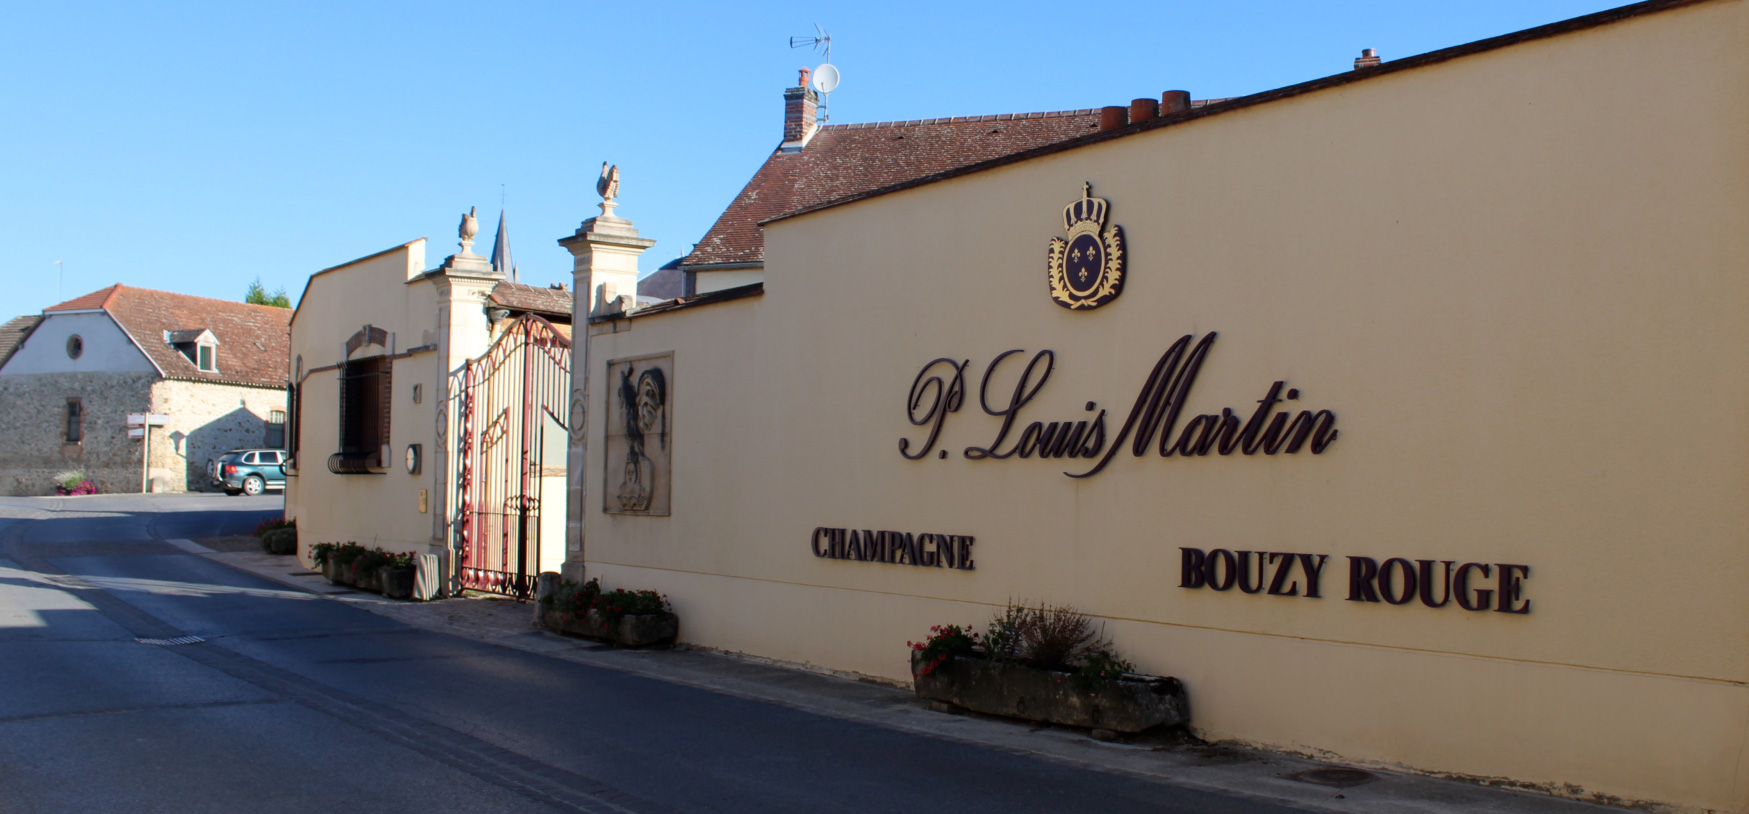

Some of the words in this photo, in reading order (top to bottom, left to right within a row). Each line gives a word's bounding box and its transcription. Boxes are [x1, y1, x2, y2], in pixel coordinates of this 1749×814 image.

[963, 349, 1107, 460] Louis
[1062, 331, 1338, 479] Martin
[811, 526, 976, 571] CHAMPAGNE
[1178, 546, 1328, 598] BOUZY
[1345, 555, 1531, 614] ROUGE
